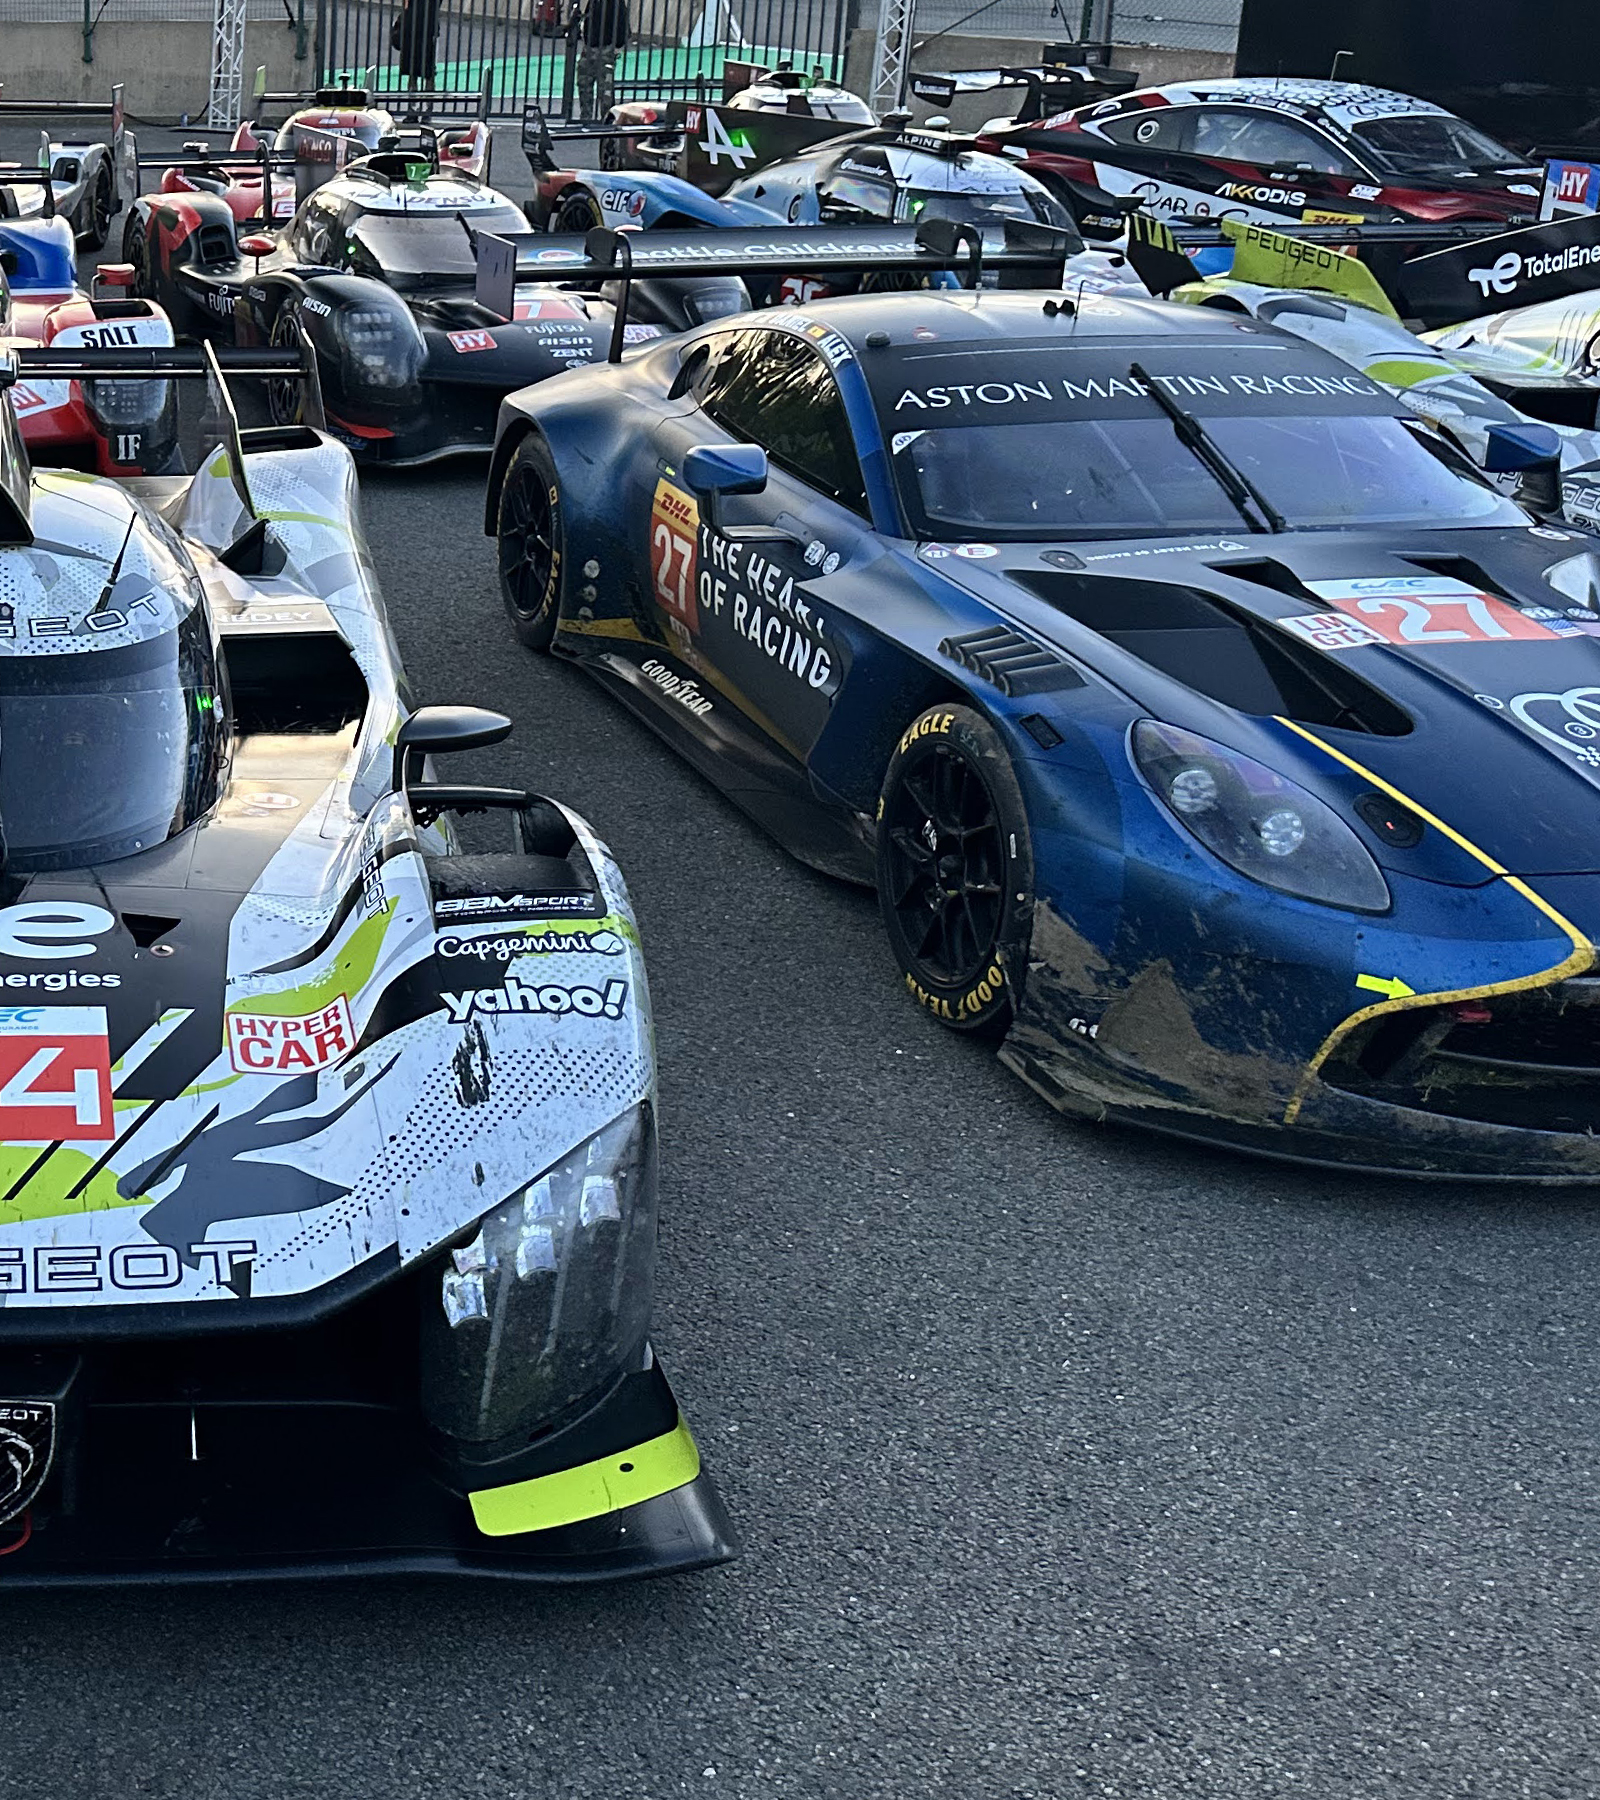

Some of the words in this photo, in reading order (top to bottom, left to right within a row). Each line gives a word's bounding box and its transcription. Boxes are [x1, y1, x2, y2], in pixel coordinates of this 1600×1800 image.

[687, 109, 700, 130] HY
[896, 134, 942, 150] ALPINE
[1131, 181, 1188, 213] CAR
[1214, 182, 1307, 206] AKKODIS
[1560, 170, 1588, 198] HY
[406, 193, 486, 206] DENSO
[602, 189, 629, 213] elf
[616, 247, 734, 260] eattle
[743, 242, 926, 258] Children's
[1245, 227, 1348, 274] PEUGEOT
[1524, 244, 1600, 279] TotalEne
[208, 292, 236, 316] FUJIT
[302, 296, 332, 318] AISIN
[526, 301, 542, 318] 7
[81, 325, 140, 348] SALT
[454, 332, 487, 350] HY
[524, 322, 585, 337] FUJITSU
[538, 336, 593, 346] AISIN
[550, 347, 594, 359] ZENT
[816, 333, 853, 369] ALEX
[893, 382, 1051, 413] ASTON
[1061, 374, 1226, 402] MARTIN
[1234, 373, 1379, 398] RACING
[116, 434, 142, 461] IF
[660, 492, 692, 526] DHL
[701, 523, 743, 581] THE
[654, 523, 692, 613] 27
[700, 570, 727, 616] OF
[733, 592, 831, 689] RACING
[1293, 614, 1352, 631] LM
[1356, 594, 1512, 642] 27
[1311, 628, 1381, 646] GT3
[641, 659, 713, 716] GOODYEAR
[899, 713, 955, 755] EAGLE
[359, 818, 390, 922] EUGEOT
[438, 932, 591, 961] Capgemini
[439, 976, 630, 1024] yahoo!
[235, 1004, 343, 1040] HYPER
[238, 1029, 349, 1071] CAR
